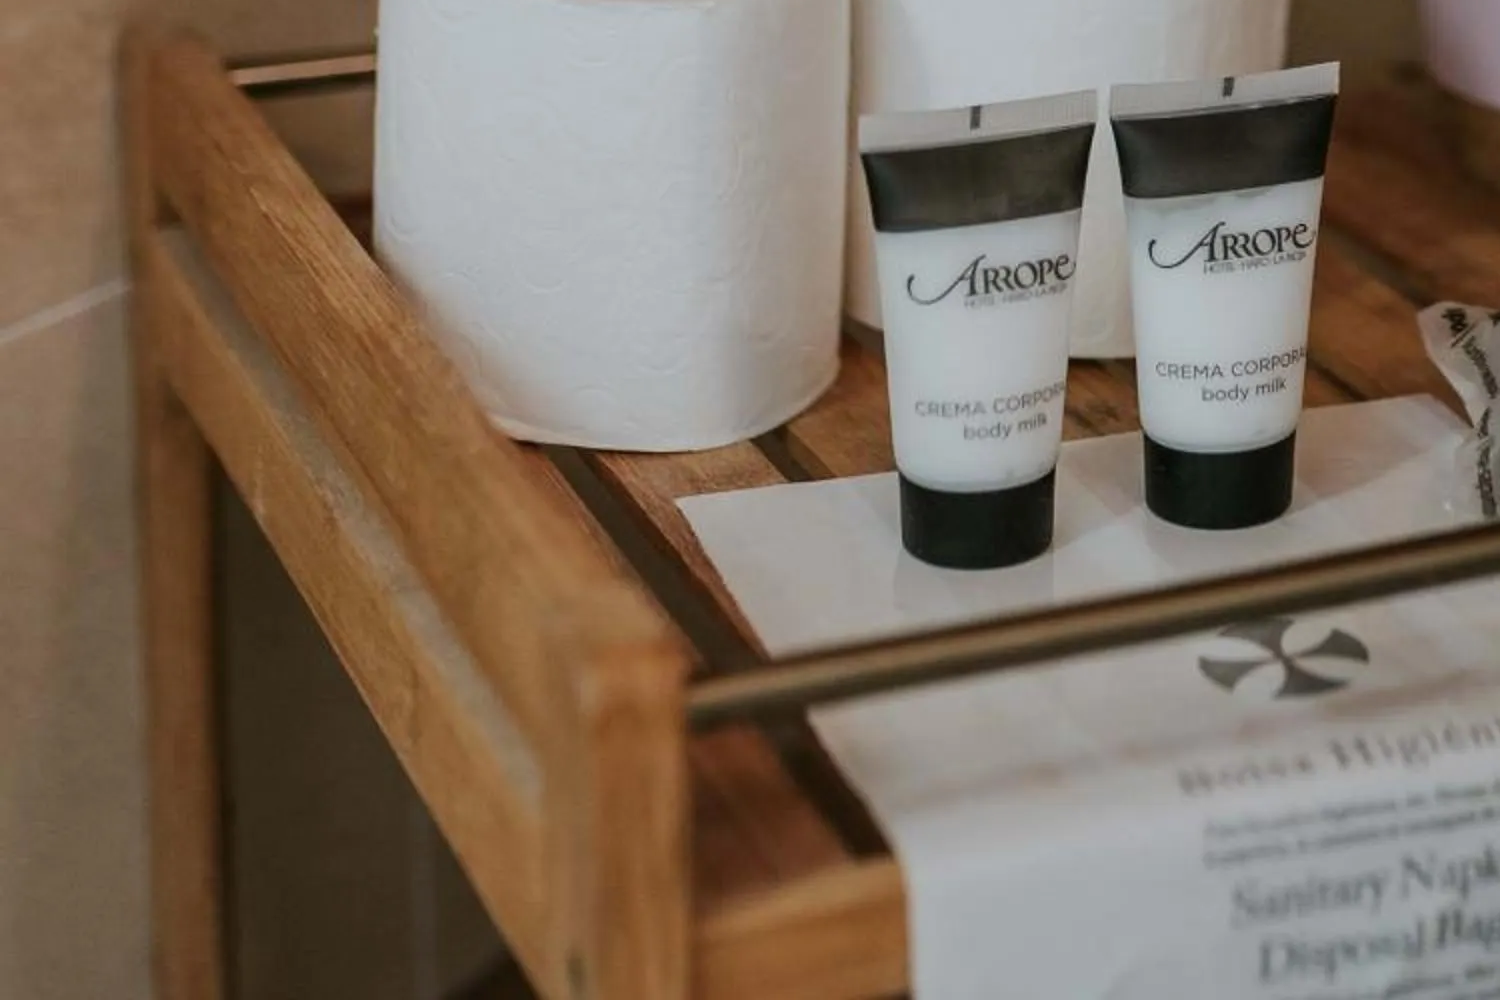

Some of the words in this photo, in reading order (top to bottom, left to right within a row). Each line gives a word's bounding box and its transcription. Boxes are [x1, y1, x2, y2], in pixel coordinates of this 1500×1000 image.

[1155, 361, 1224, 380] CREMA
[1201, 383, 1249, 403] body
[1255, 376, 1288, 396] milk
[914, 400, 986, 419] CREMA
[963, 421, 1012, 441] body
[1016, 411, 1048, 433] milk
[1231, 868, 1385, 926] Sanitary
